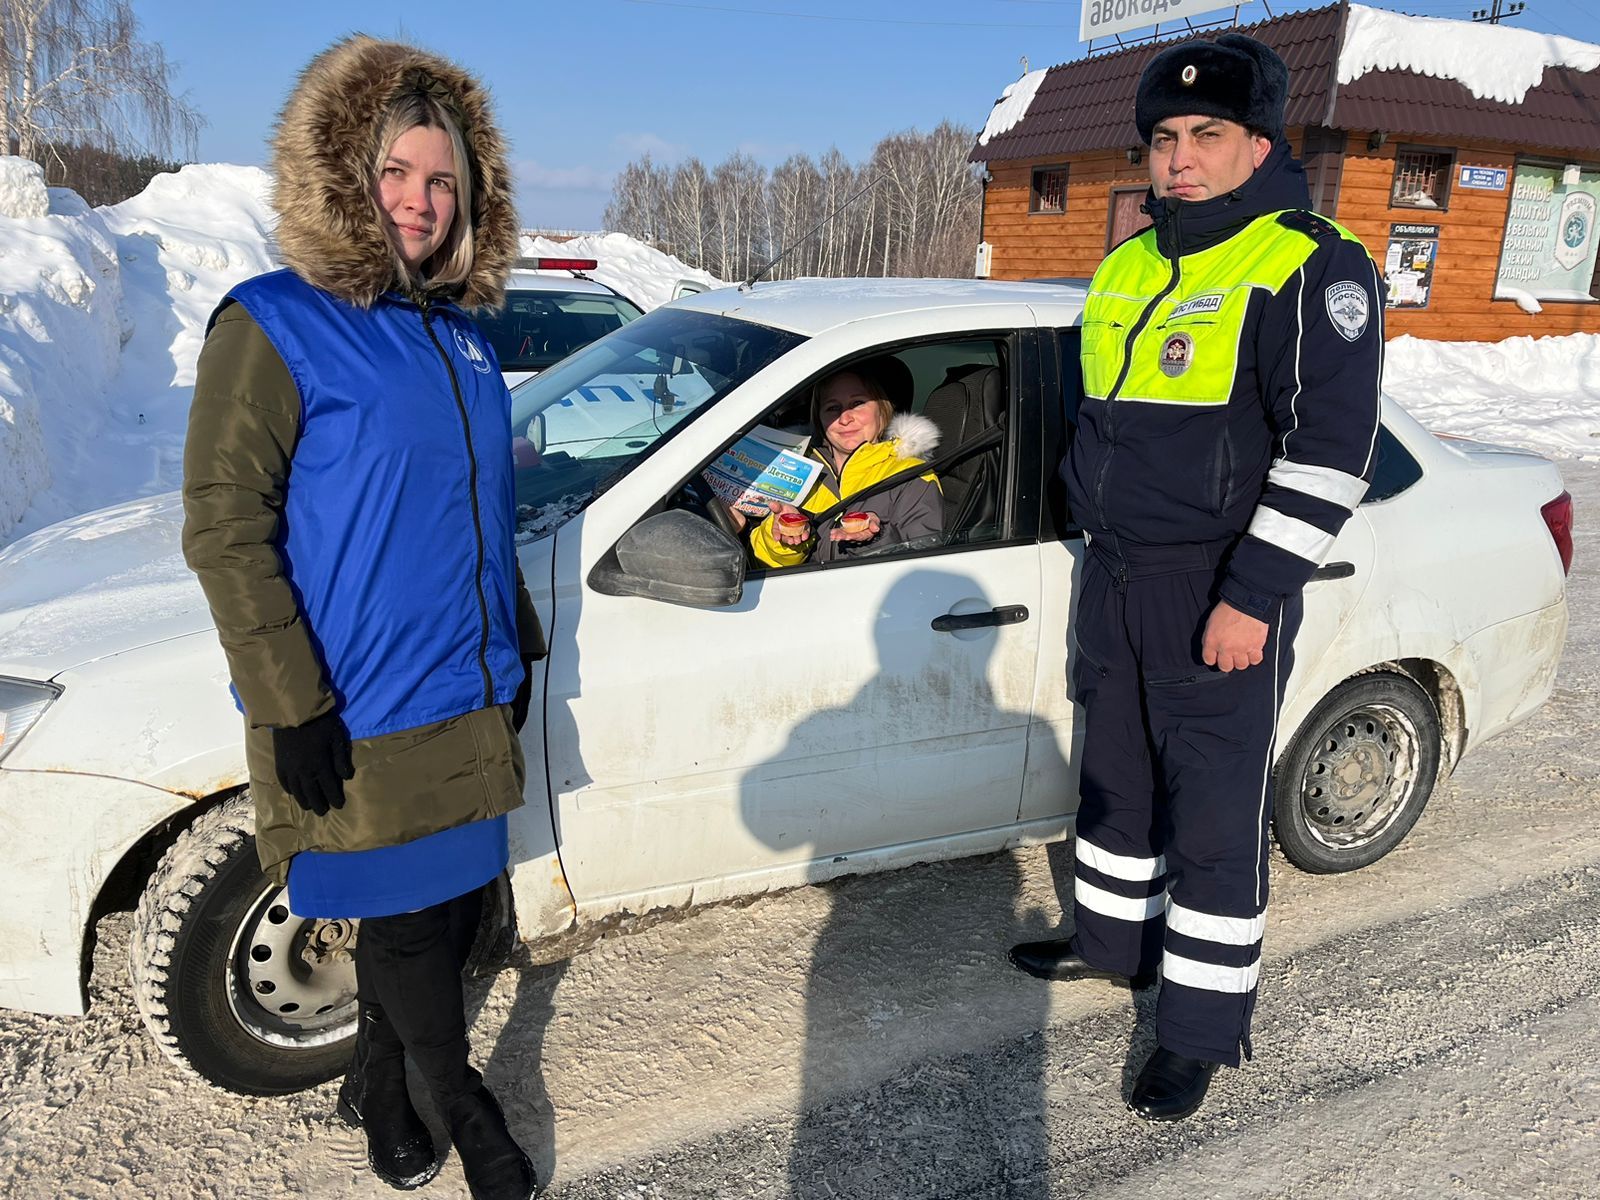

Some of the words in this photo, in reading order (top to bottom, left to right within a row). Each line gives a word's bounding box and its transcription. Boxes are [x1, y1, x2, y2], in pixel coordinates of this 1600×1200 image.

[1090, 0, 1182, 26] авокад
[1506, 252, 1535, 266] ЧЕХИИ
[1187, 297, 1218, 310] ГИБДД
[768, 466, 804, 485] Детства
